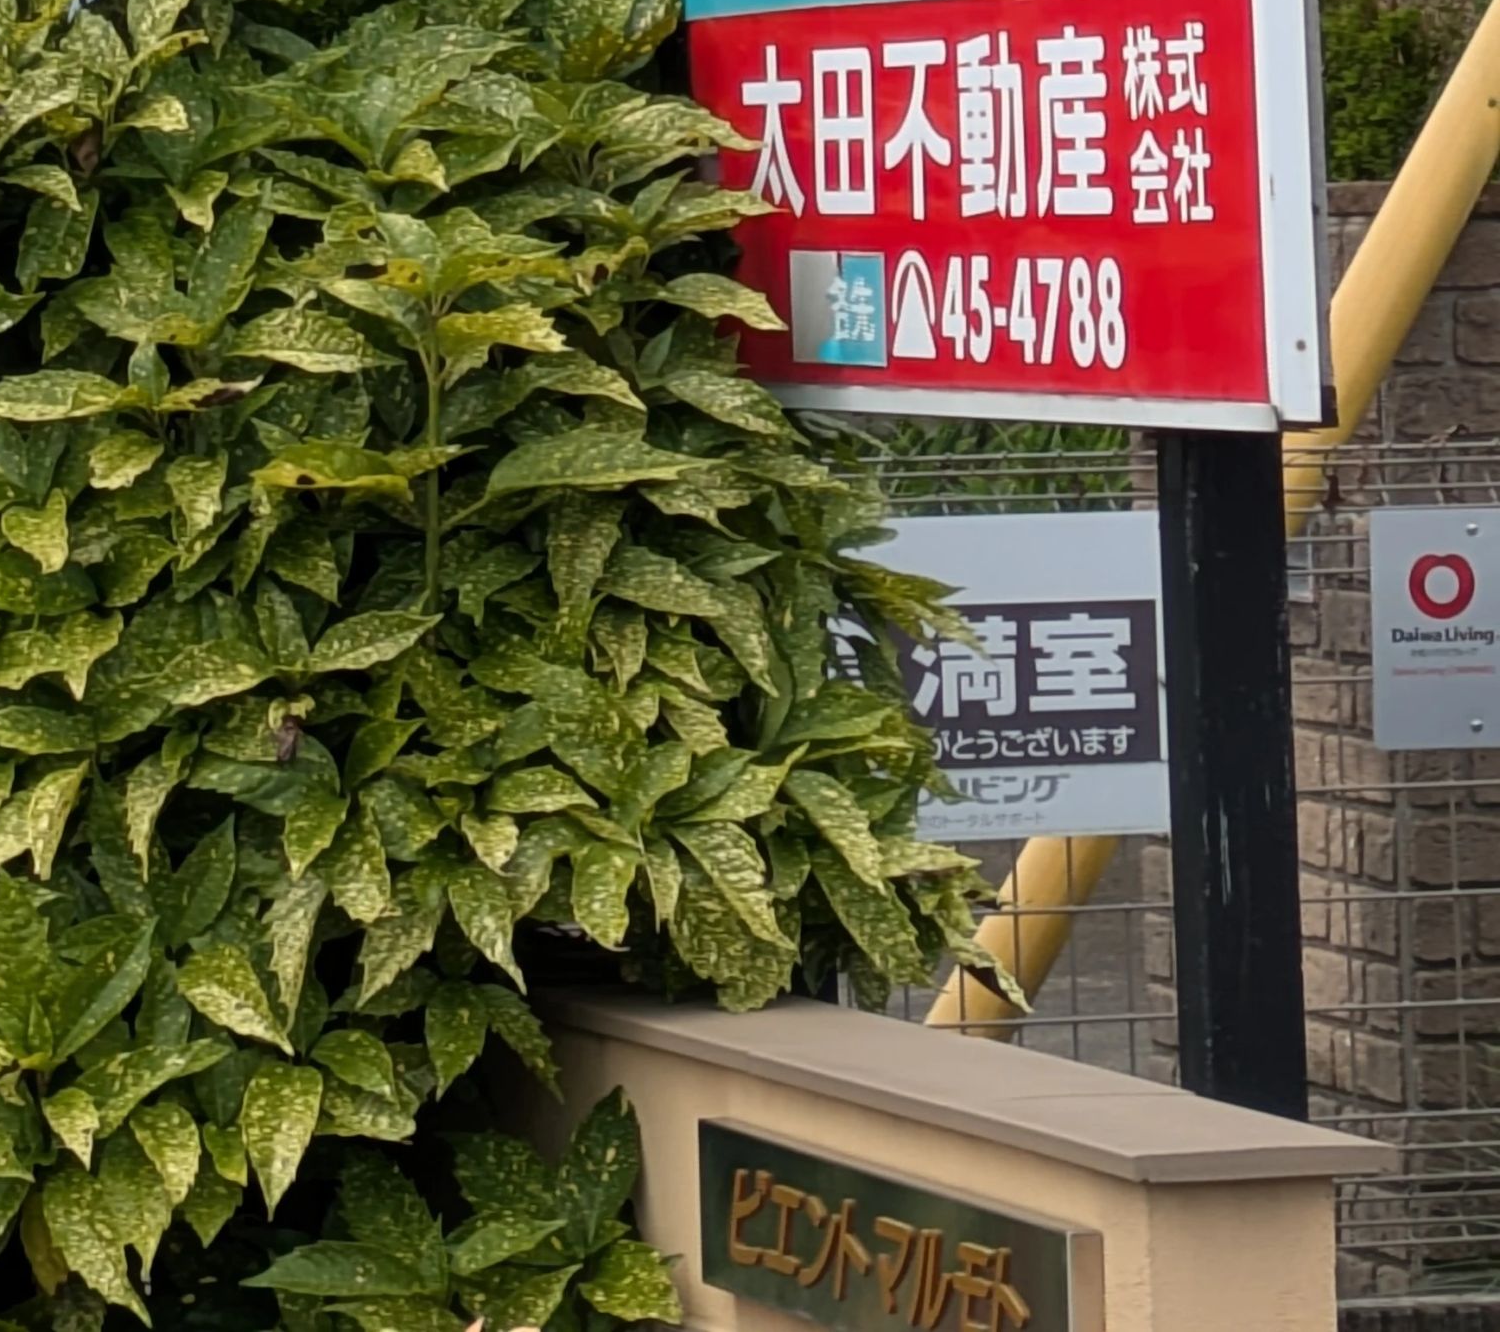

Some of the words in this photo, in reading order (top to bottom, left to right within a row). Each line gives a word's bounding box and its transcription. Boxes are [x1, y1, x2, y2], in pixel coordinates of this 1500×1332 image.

[1122, 21, 1207, 120] 株式
[741, 26, 1113, 221] 太田不動産
[1130, 127, 1214, 224] 会社
[941, 254, 1126, 369] 45-4788
[827, 604, 1137, 718] 満室
[1391, 627, 1442, 643] Daiwa
[1444, 626, 1495, 645] Living
[918, 773, 1071, 806] リビング
